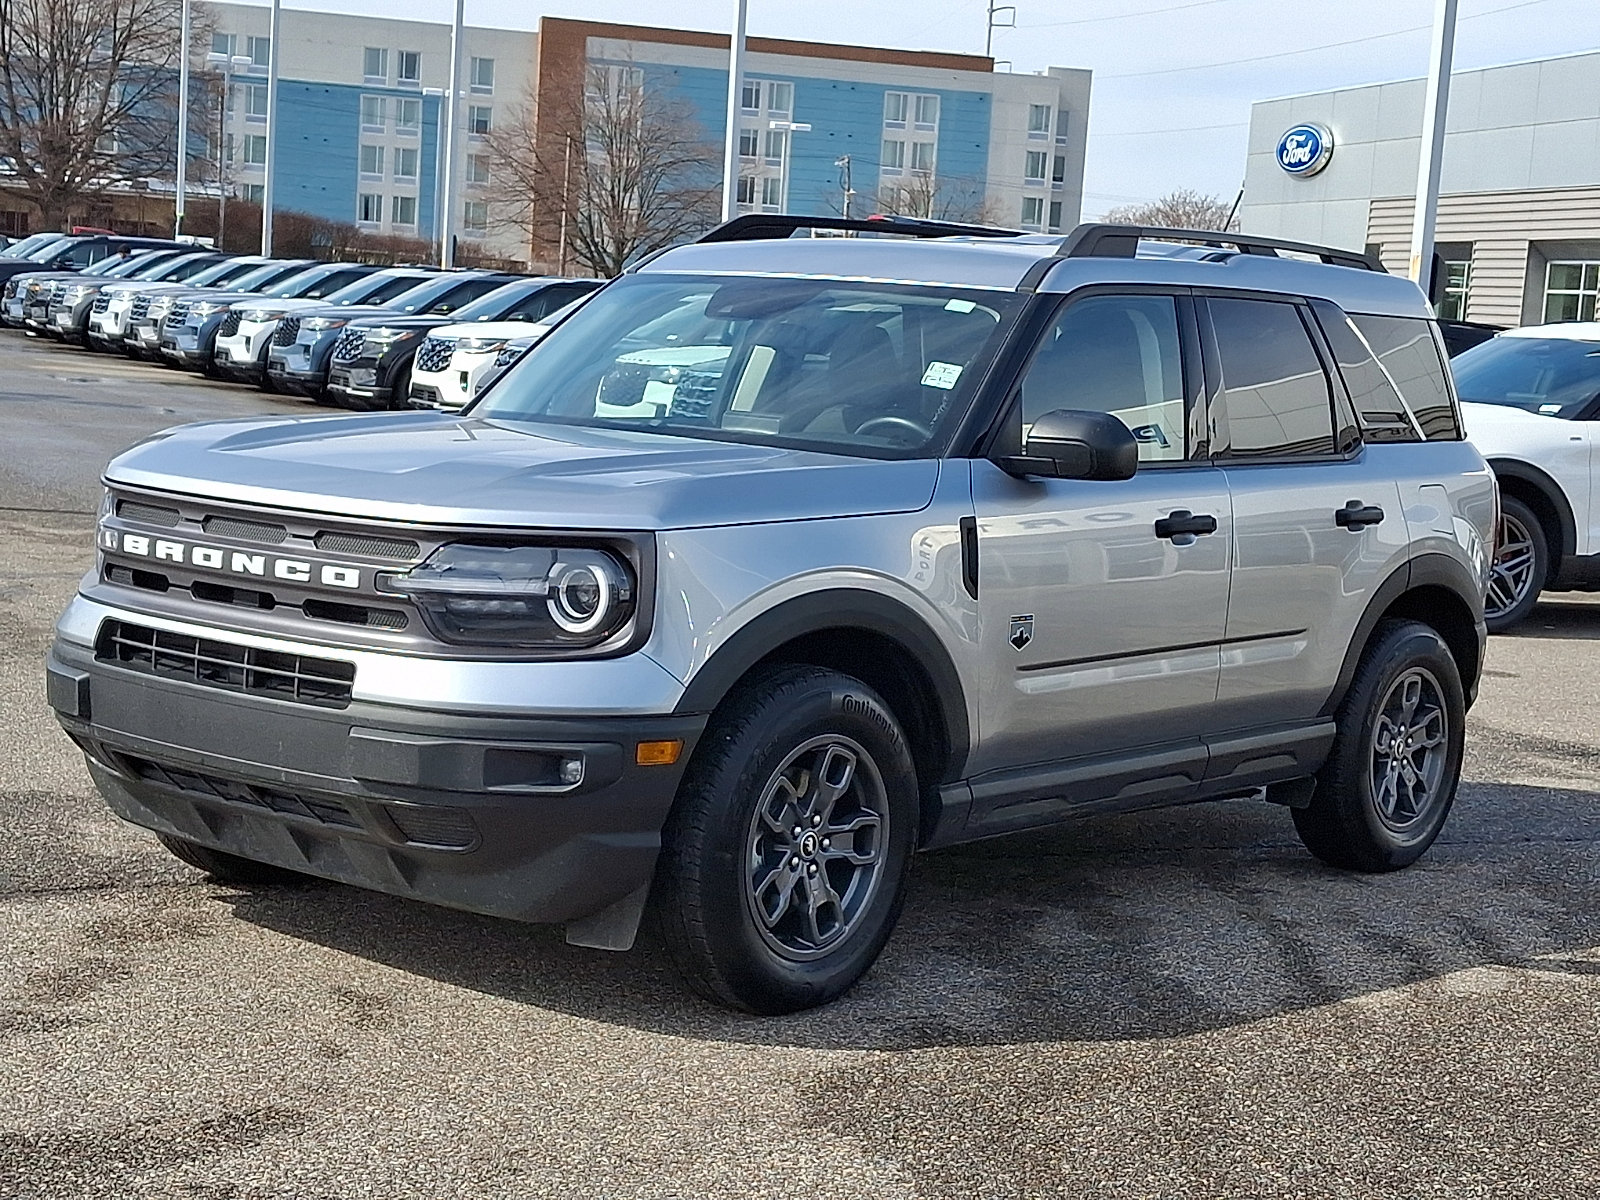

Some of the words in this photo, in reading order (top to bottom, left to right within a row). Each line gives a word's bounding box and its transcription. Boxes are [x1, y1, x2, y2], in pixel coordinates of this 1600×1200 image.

[1283, 134, 1313, 165] Ford
[123, 533, 360, 589] BRONCO
[842, 694, 899, 746] Continental
